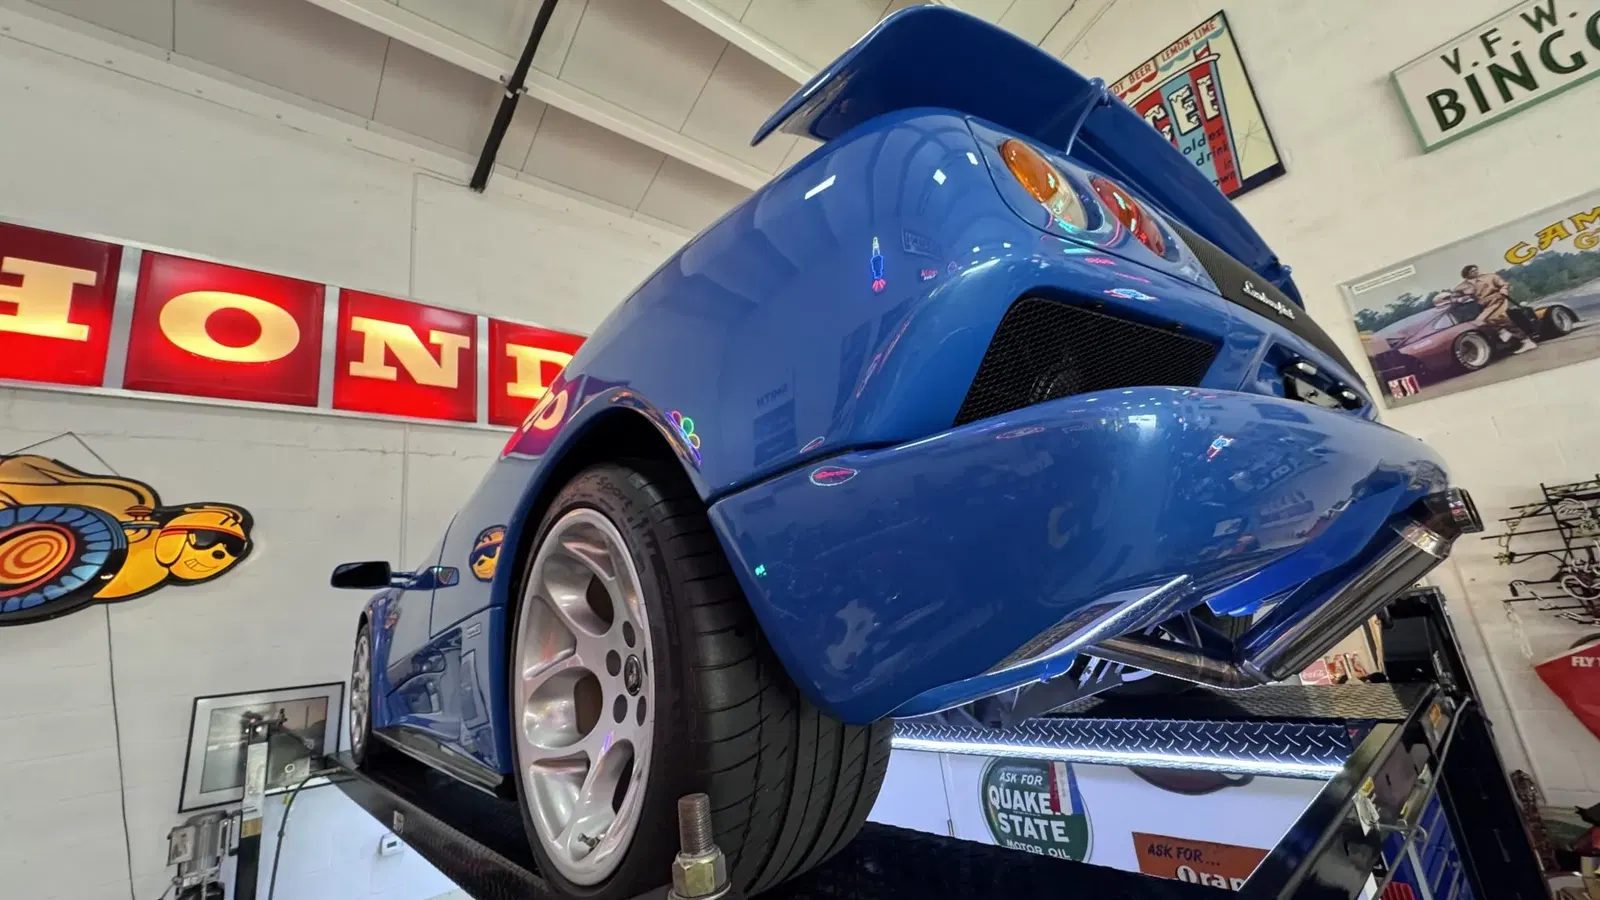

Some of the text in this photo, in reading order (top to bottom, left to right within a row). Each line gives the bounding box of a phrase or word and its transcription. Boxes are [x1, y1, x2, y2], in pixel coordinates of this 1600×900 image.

[1161, 20, 1217, 62] LEMON-LIME
[1128, 63, 1152, 83] BEER
[1571, 656, 1595, 668] FLY
[999, 772, 1043, 786] ASK FOR
[998, 812, 1070, 843] STATE
[1006, 839, 1070, 858] MOTOR OIL
[1148, 844, 1173, 859] ASK
